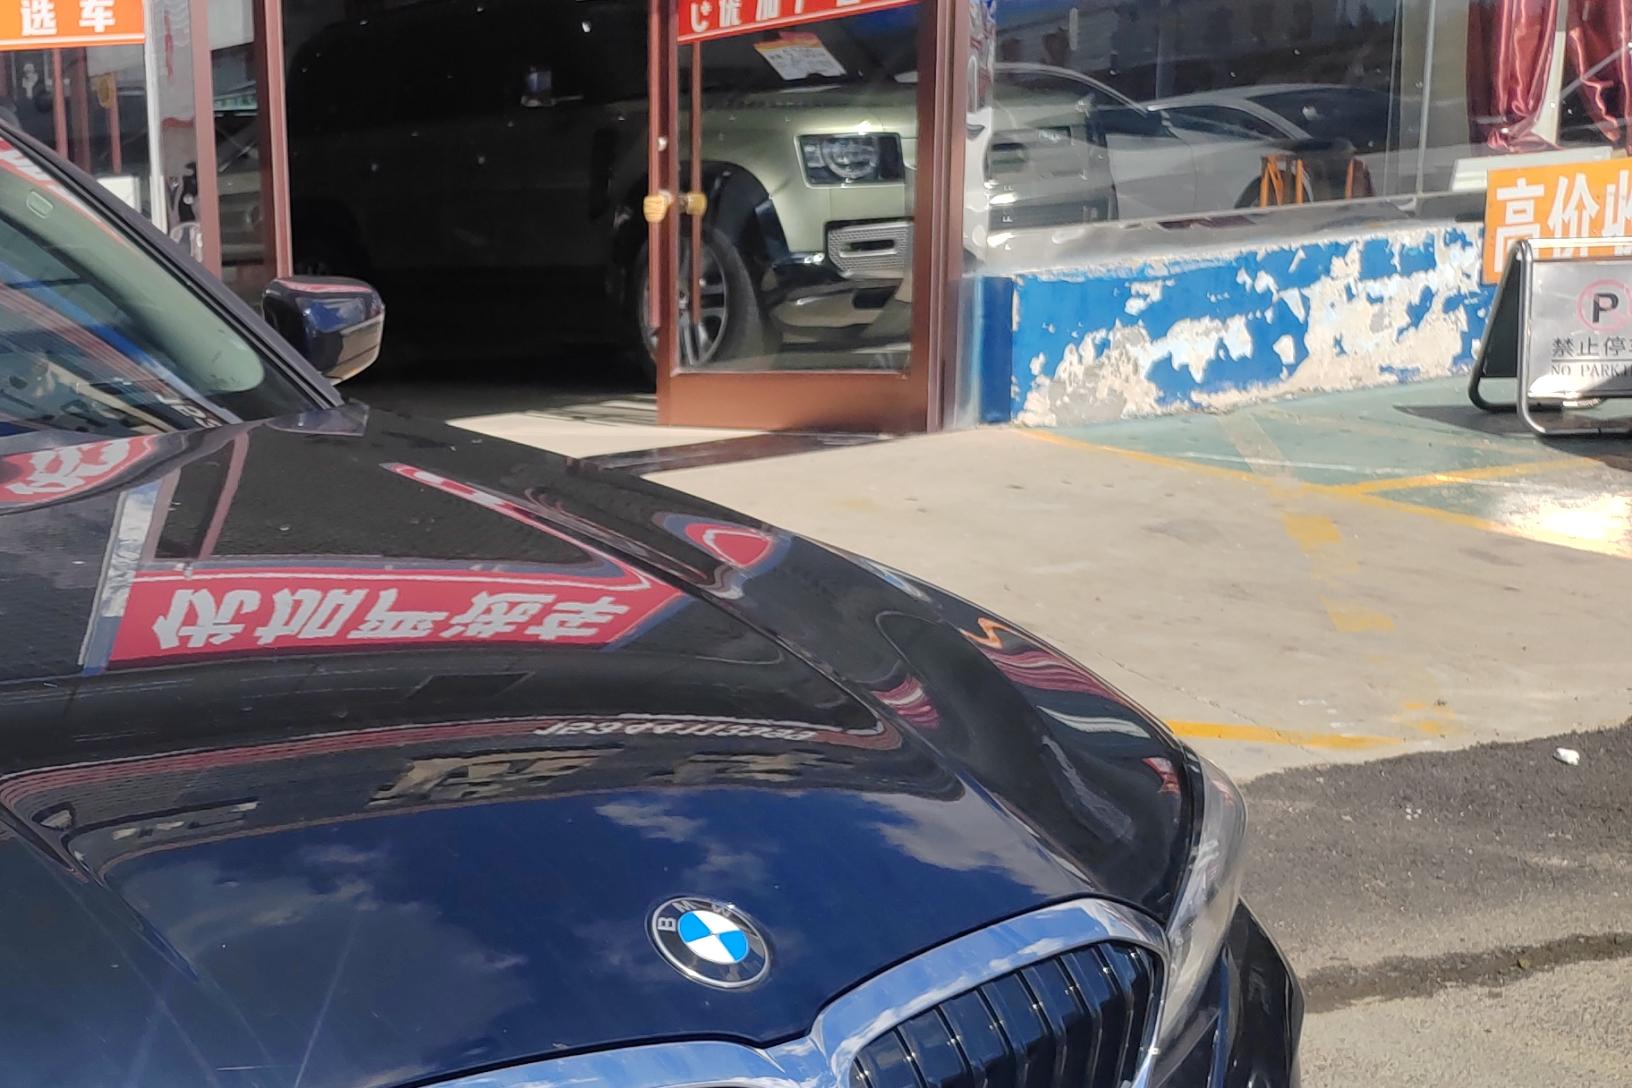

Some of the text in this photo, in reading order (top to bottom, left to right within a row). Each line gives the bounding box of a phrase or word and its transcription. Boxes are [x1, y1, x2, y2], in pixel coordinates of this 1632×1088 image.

[1591, 292, 1619, 324] P
[1551, 336, 1632, 357] 禁止停
[1551, 363, 1632, 378] NO PARKI
